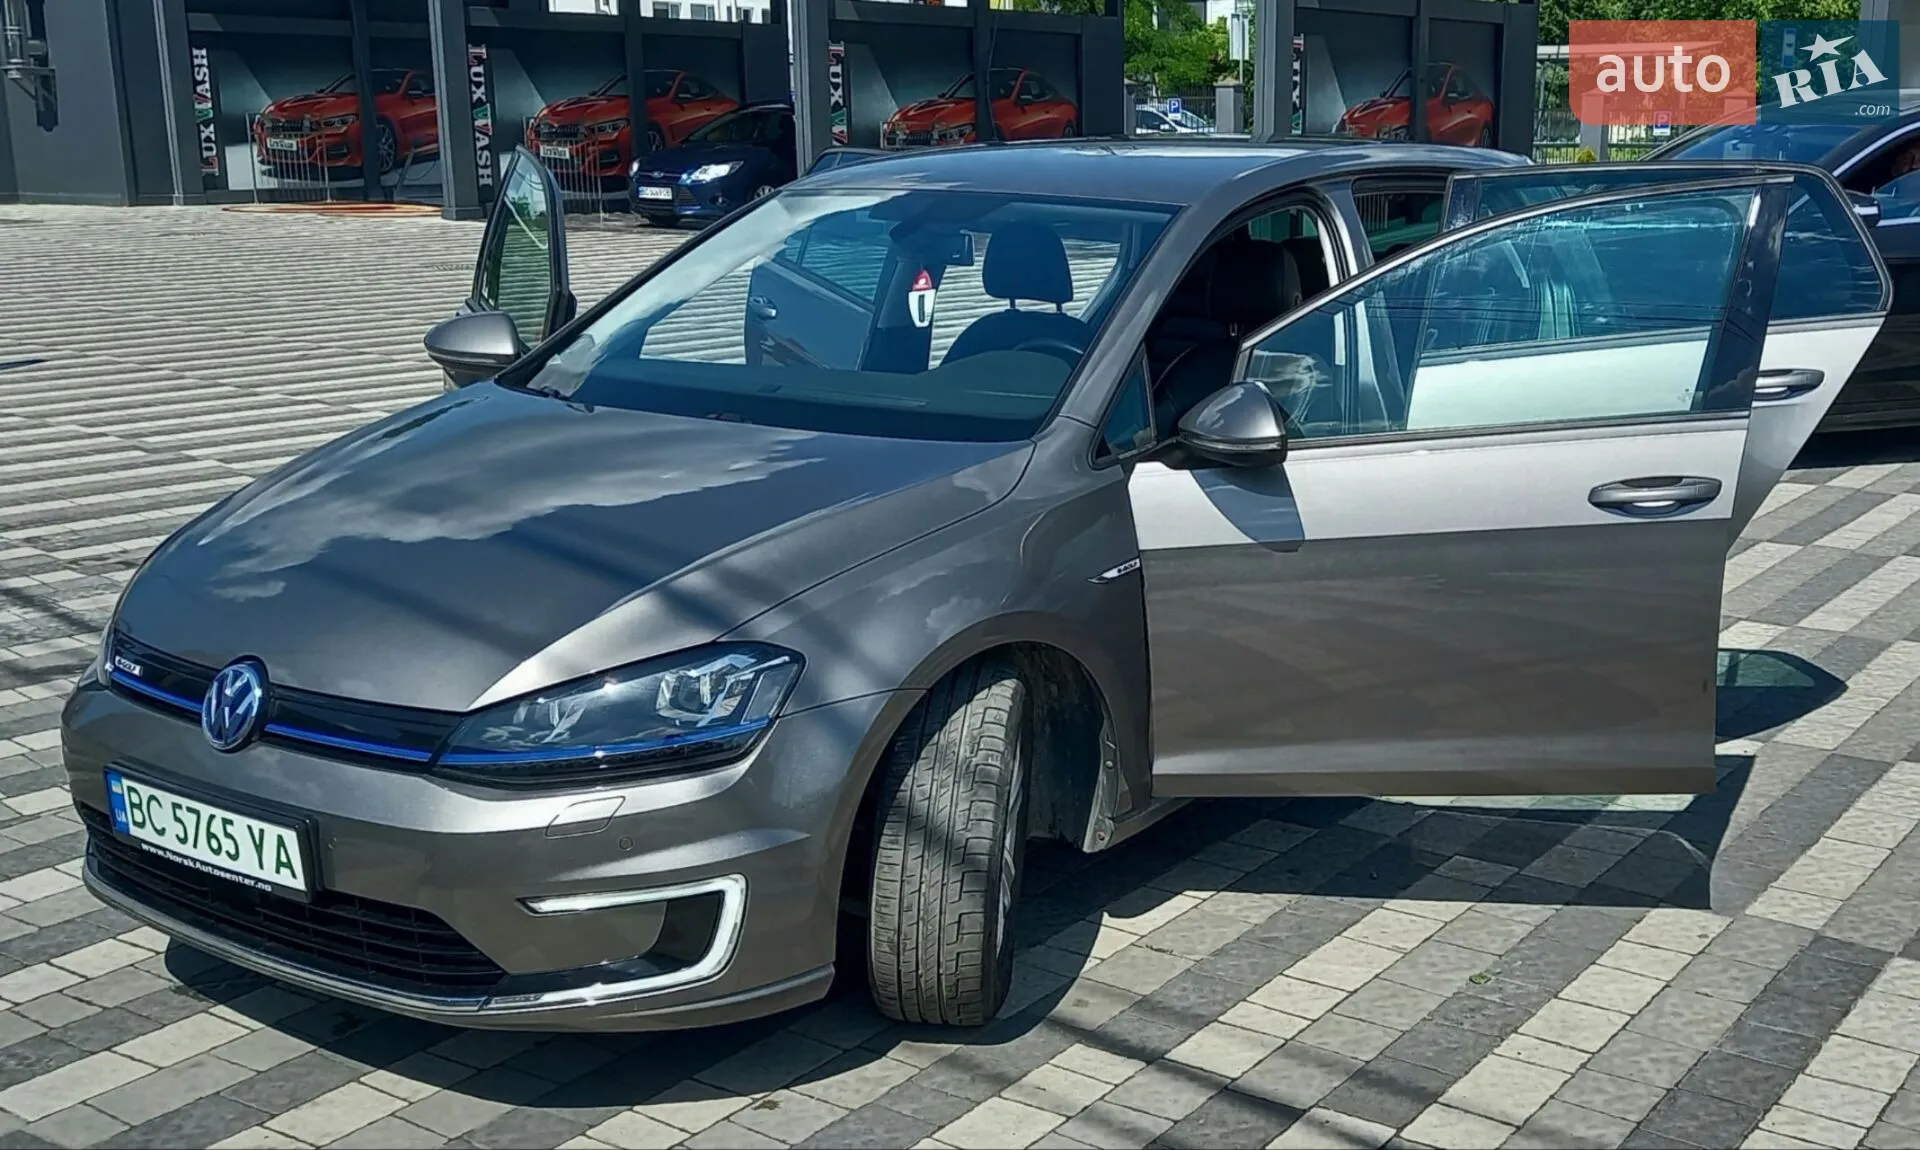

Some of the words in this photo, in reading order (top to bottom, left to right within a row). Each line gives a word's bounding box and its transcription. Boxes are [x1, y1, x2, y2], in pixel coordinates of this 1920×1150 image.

[1170, 100, 1179, 112] P
[115, 808, 128, 824] UA
[126, 785, 166, 837] BC
[171, 801, 240, 862] 5765
[246, 823, 297, 880] YA
